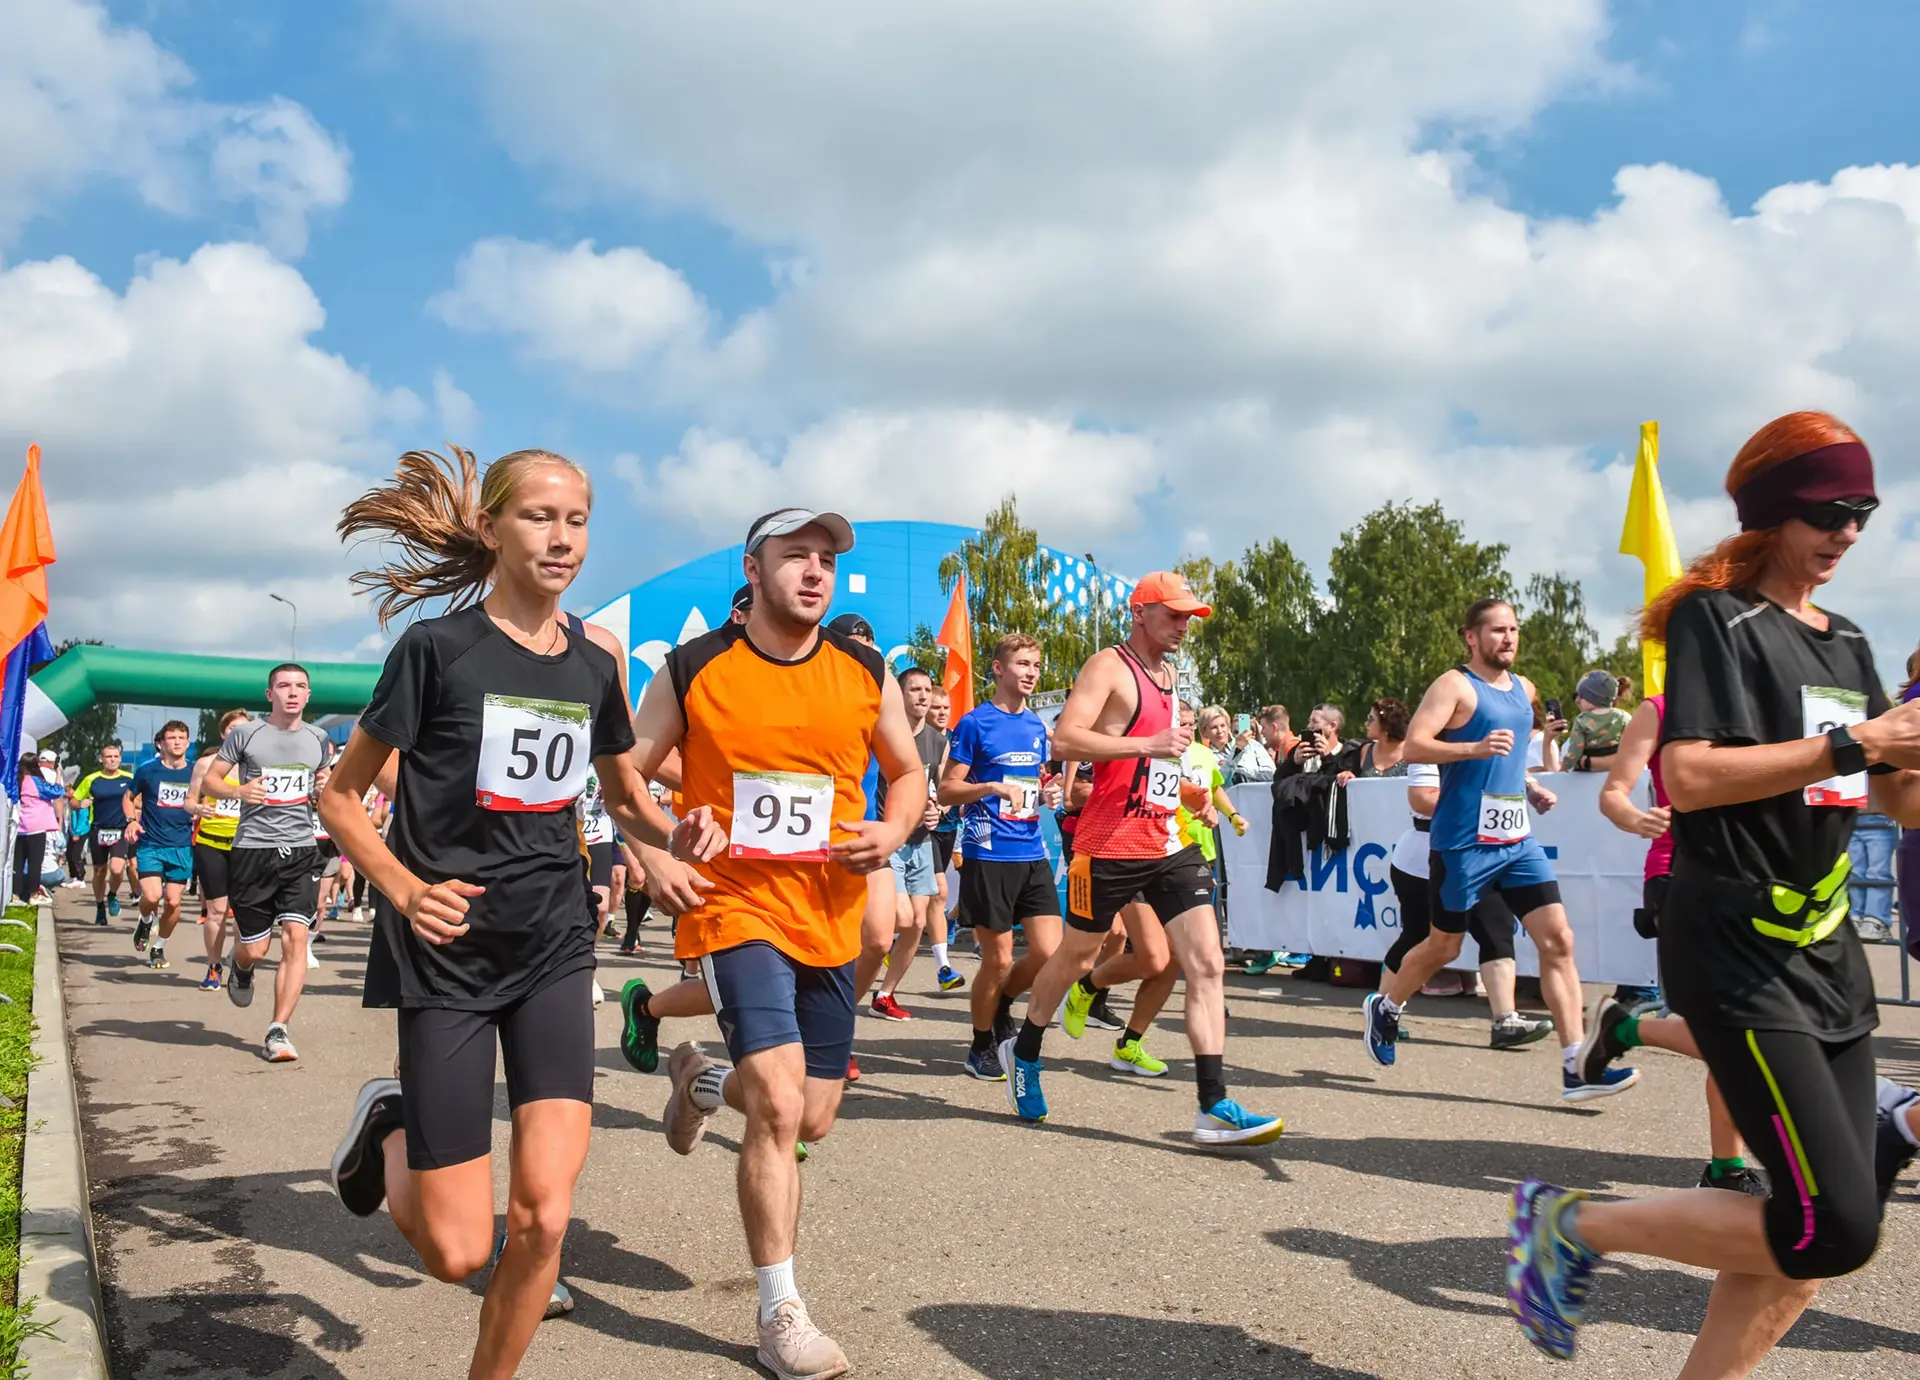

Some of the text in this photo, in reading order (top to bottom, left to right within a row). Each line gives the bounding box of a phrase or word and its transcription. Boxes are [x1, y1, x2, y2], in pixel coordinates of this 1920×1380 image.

[507, 728, 574, 782] 50
[1010, 753, 1032, 763] SOCHI
[161, 788, 187, 801] 394
[266, 774, 306, 794] 374
[752, 794, 812, 836] 95
[1483, 808, 1524, 831] 380
[1016, 1067, 1026, 1098] HOKA
